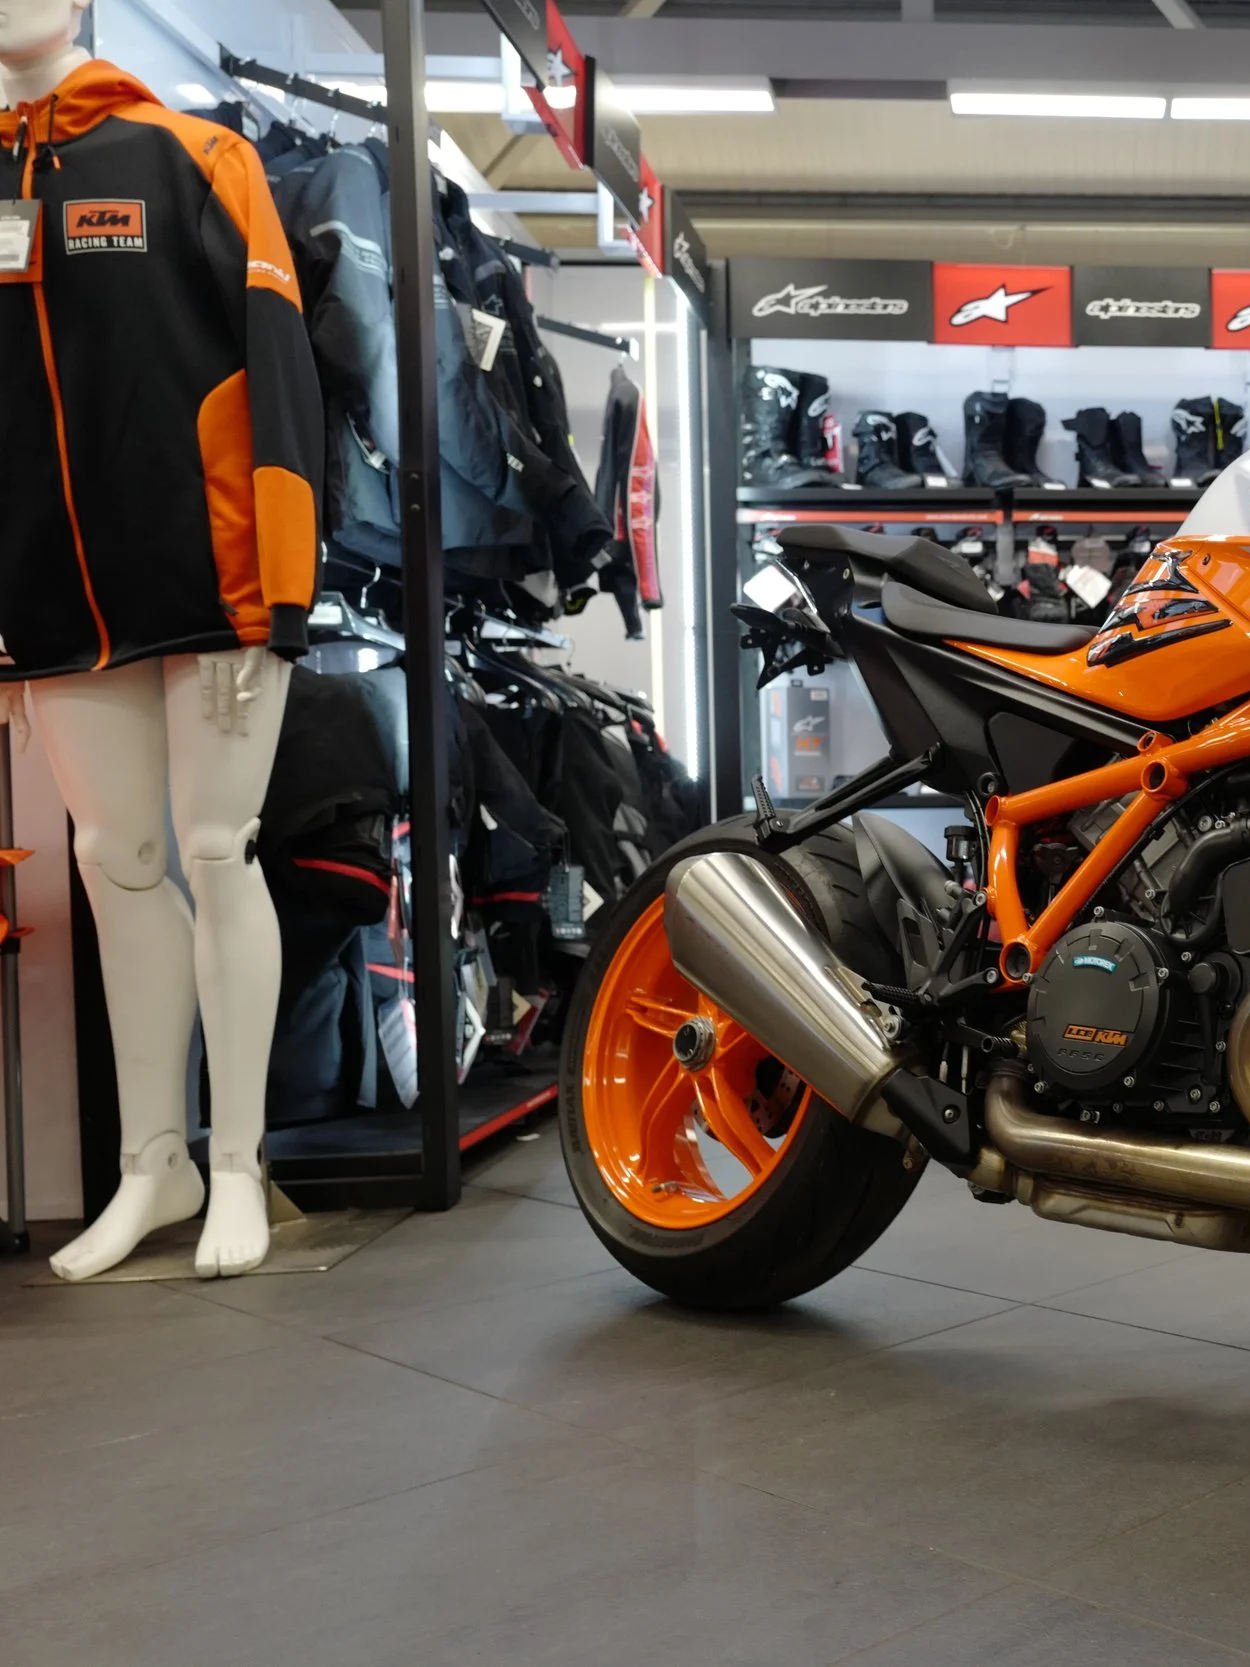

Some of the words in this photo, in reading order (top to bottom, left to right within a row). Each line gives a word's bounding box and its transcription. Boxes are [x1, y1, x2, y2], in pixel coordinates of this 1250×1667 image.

[76, 210, 131, 228] KTM
[68, 237, 108, 250] RACING
[112, 236, 143, 249] TEAM
[1085, 298, 1201, 319] alpinestars
[1095, 1030, 1129, 1046] KTM
